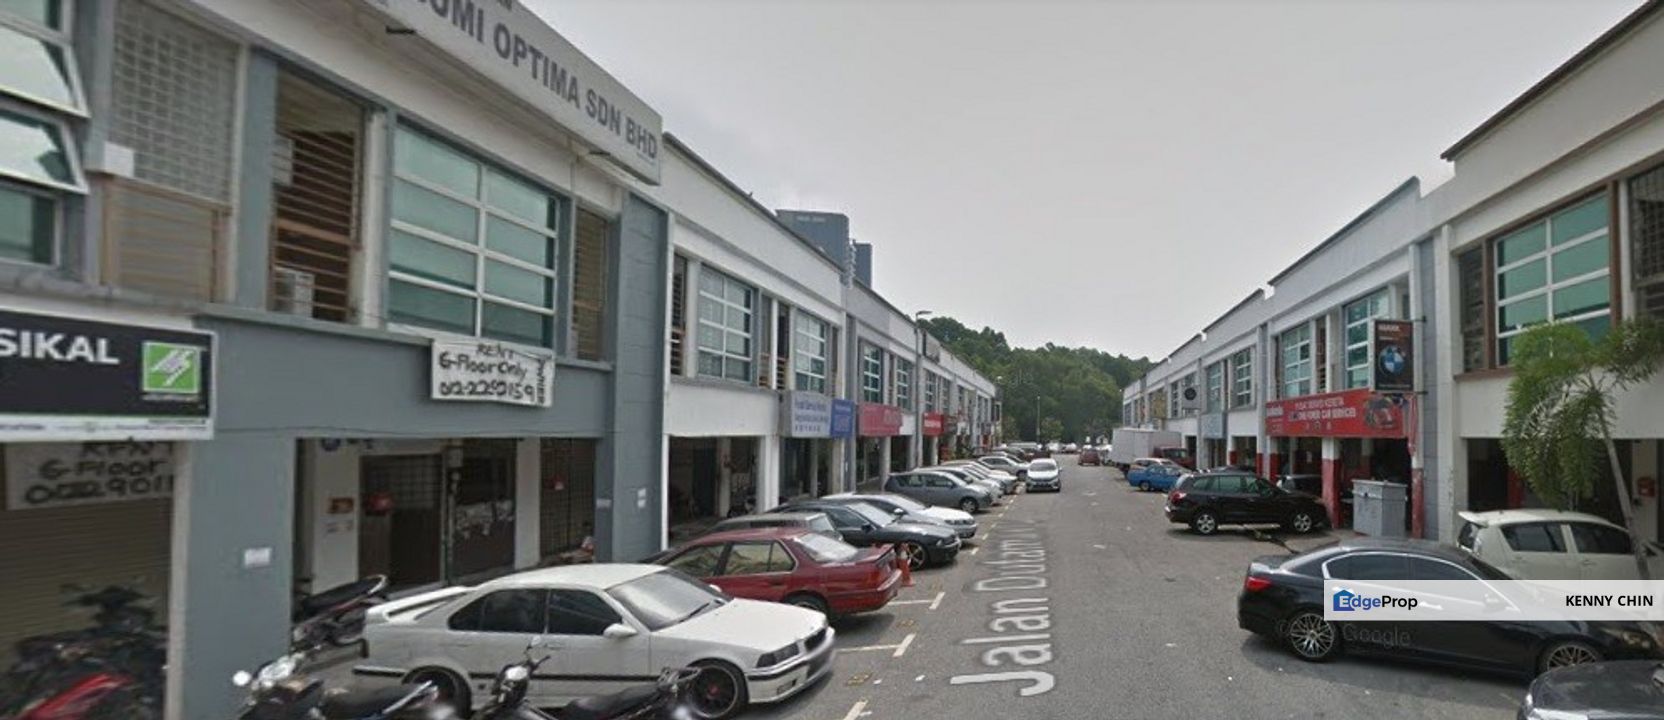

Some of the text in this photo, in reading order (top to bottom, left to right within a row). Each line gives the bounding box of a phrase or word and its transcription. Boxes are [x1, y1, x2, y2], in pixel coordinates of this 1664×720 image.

[417, 0, 658, 160] MI OPTIMA SDN BHD
[0, 327, 120, 365] SIKAL
